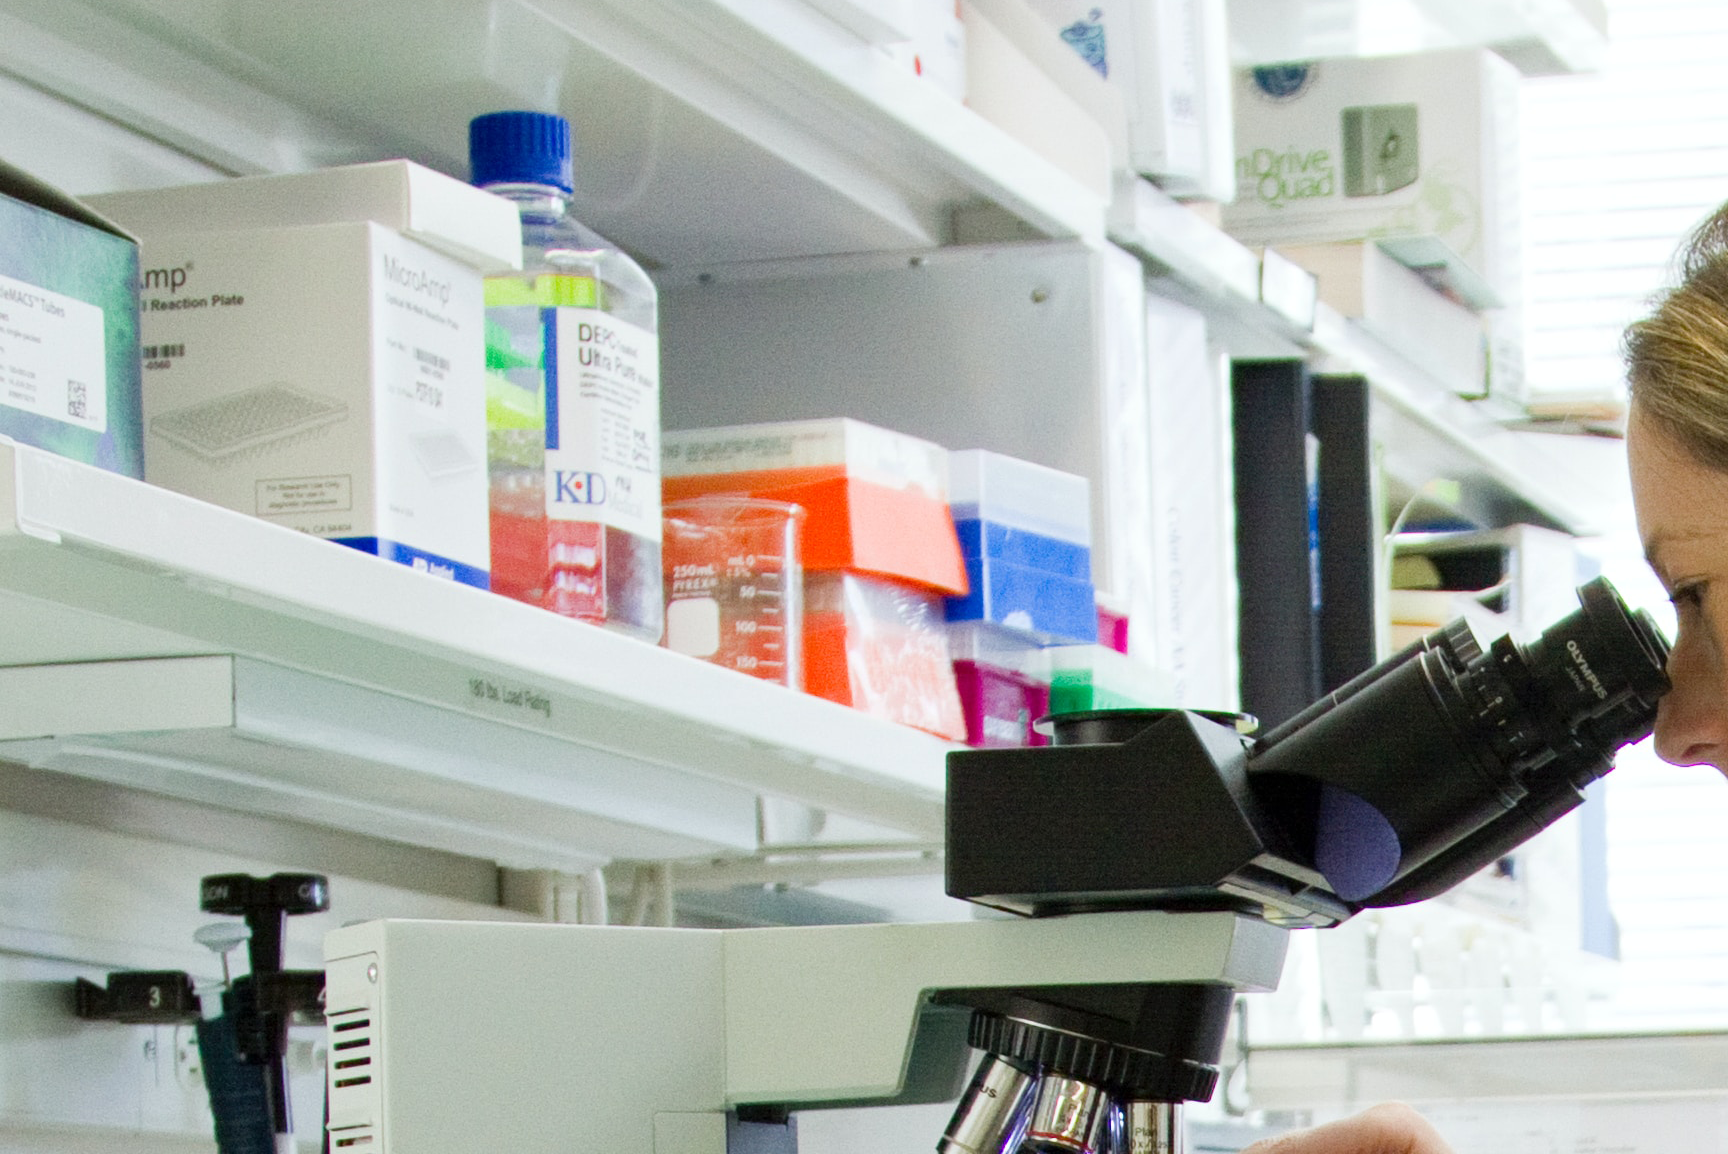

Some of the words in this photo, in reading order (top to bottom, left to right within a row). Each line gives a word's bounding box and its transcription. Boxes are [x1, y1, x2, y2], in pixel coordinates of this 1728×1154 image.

[1257, 167, 1335, 208] Quad
[151, 298, 208, 311] Reaction
[211, 294, 244, 306] Plate
[578, 347, 611, 372] Ultra
[615, 356, 636, 382] Pure
[740, 585, 756, 598] 50
[736, 620, 757, 634] 100
[737, 655, 758, 669] 150
[1567, 641, 1608, 699] OLYMPUS
[503, 685, 522, 706] Load
[525, 690, 551, 718] Rating
[149, 986, 161, 1008] 3
